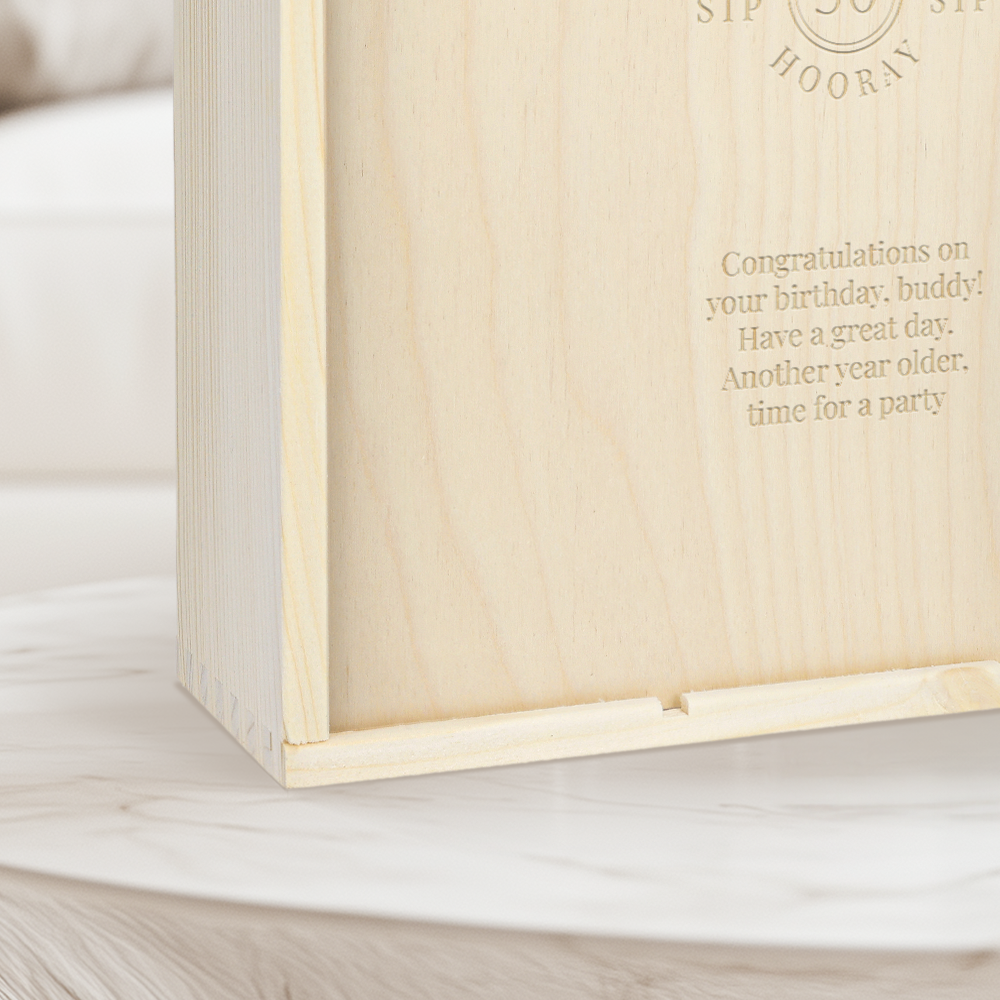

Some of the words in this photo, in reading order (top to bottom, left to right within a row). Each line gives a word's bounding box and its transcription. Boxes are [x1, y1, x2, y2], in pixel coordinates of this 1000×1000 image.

[768, 39, 920, 100] HOORAY
[721, 240, 930, 278] Congratulations
[937, 241, 969, 262] on
[706, 293, 767, 322] your
[897, 270, 984, 303] buddy!
[738, 326, 803, 352] Have
[810, 327, 825, 346] a
[830, 316, 898, 350] great
[904, 312, 954, 341] day.
[721, 360, 829, 392] Another
[834, 357, 891, 387] year
[897, 348, 970, 376] older,
[746, 400, 806, 427] time
[814, 395, 852, 421] for
[858, 398, 872, 417] a
[879, 389, 947, 420] party
